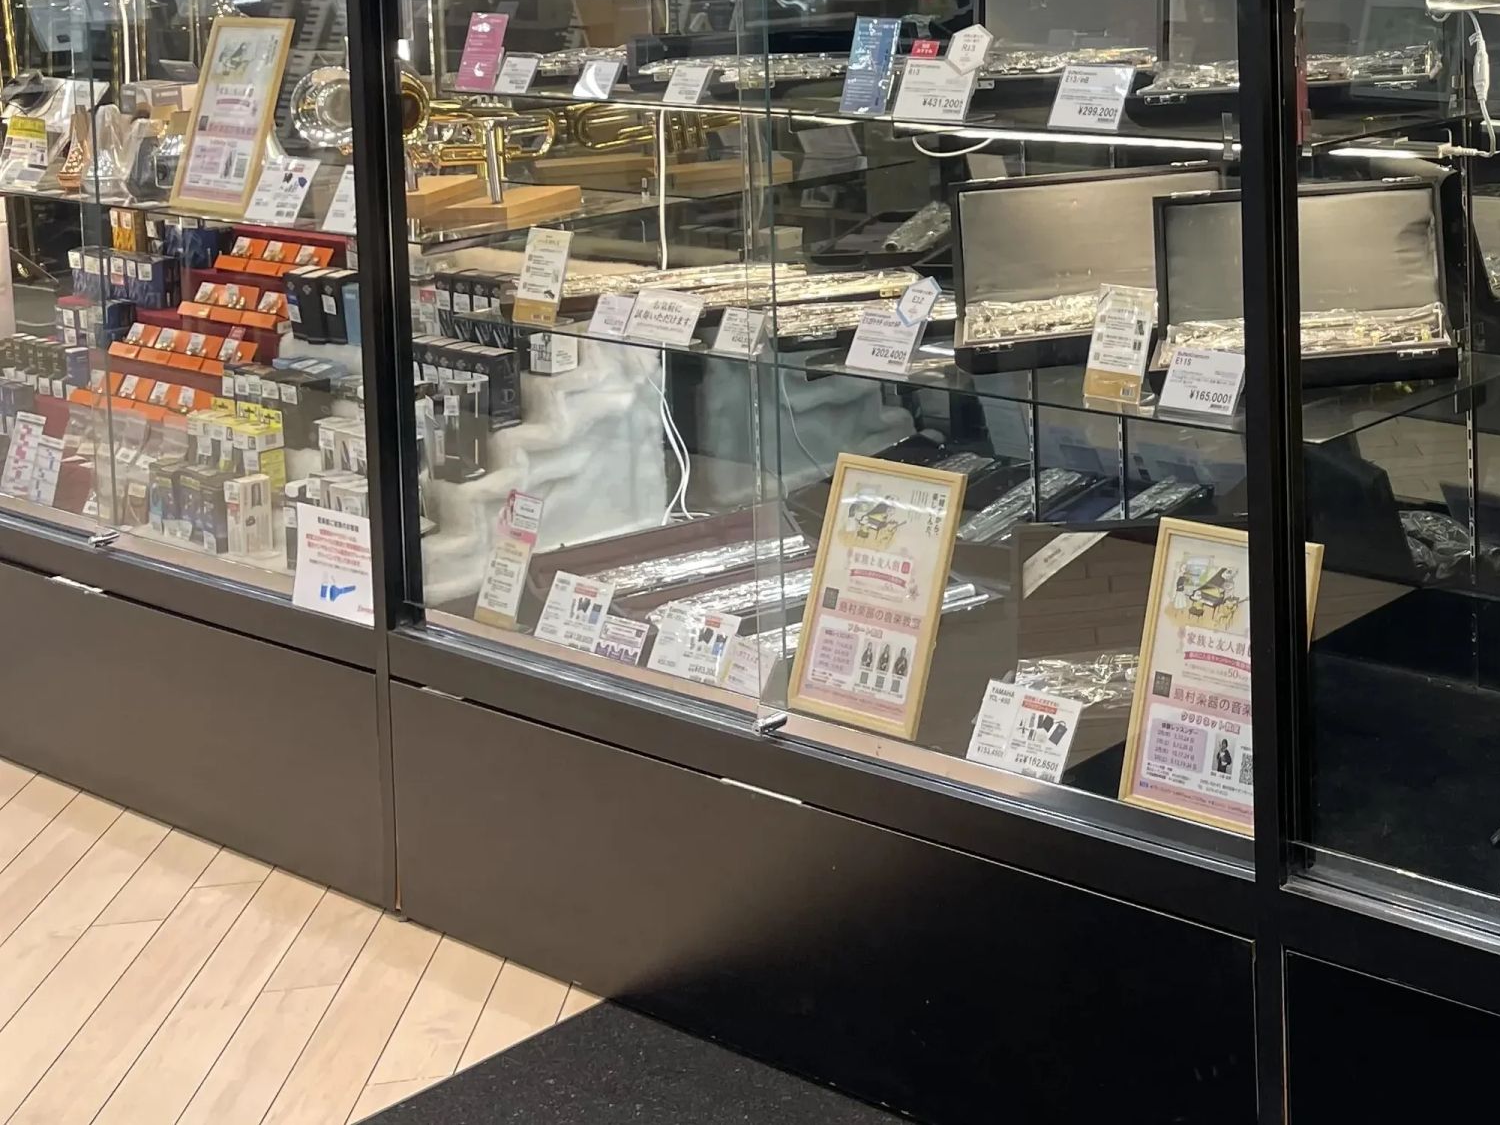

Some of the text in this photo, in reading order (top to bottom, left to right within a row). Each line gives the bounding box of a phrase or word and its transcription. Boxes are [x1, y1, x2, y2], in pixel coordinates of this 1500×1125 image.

[1186, 632, 1245, 657] 家族と友人割
[991, 686, 1015, 698] YAMAHA
